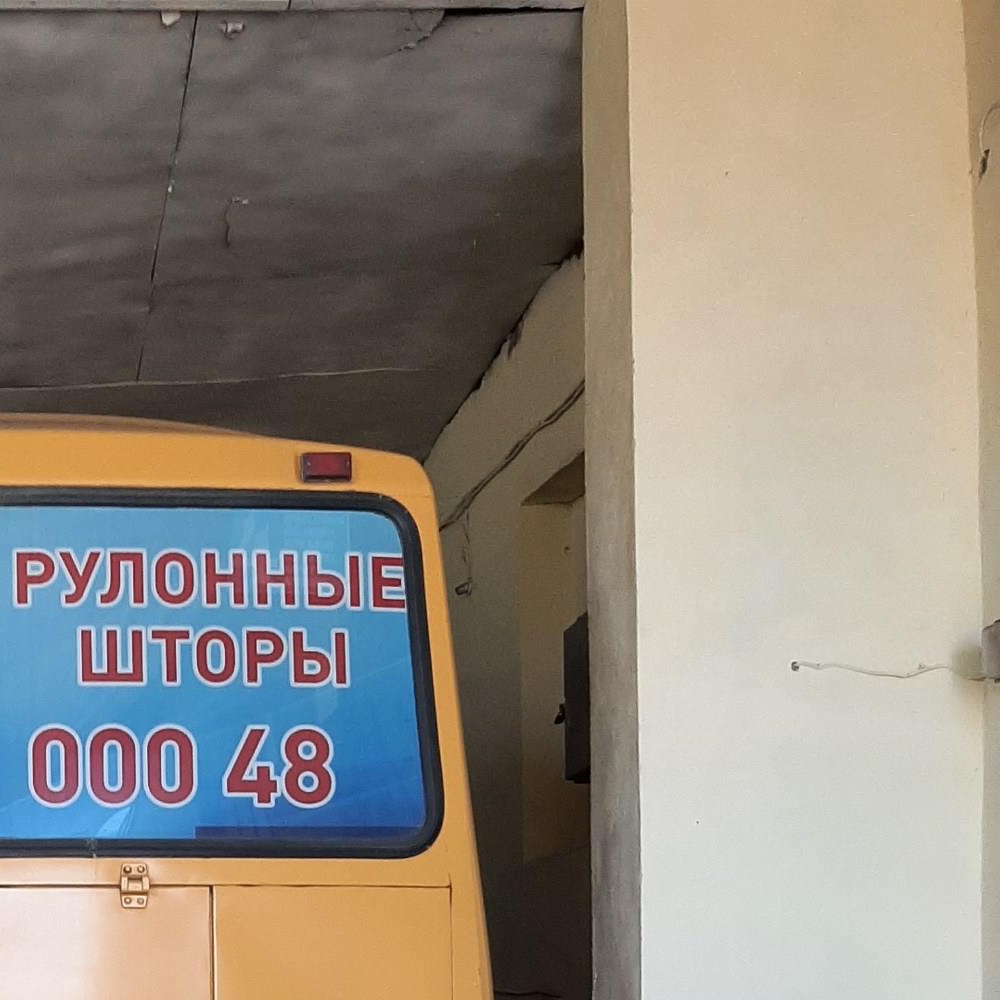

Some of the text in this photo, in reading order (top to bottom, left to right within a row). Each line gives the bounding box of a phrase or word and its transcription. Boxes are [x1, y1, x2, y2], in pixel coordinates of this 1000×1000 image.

[12, 547, 406, 612] РУЛОННЫЕ
[77, 625, 351, 688] ШТОРЫ
[28, 722, 198, 808] 000
[222, 724, 335, 809] 48
